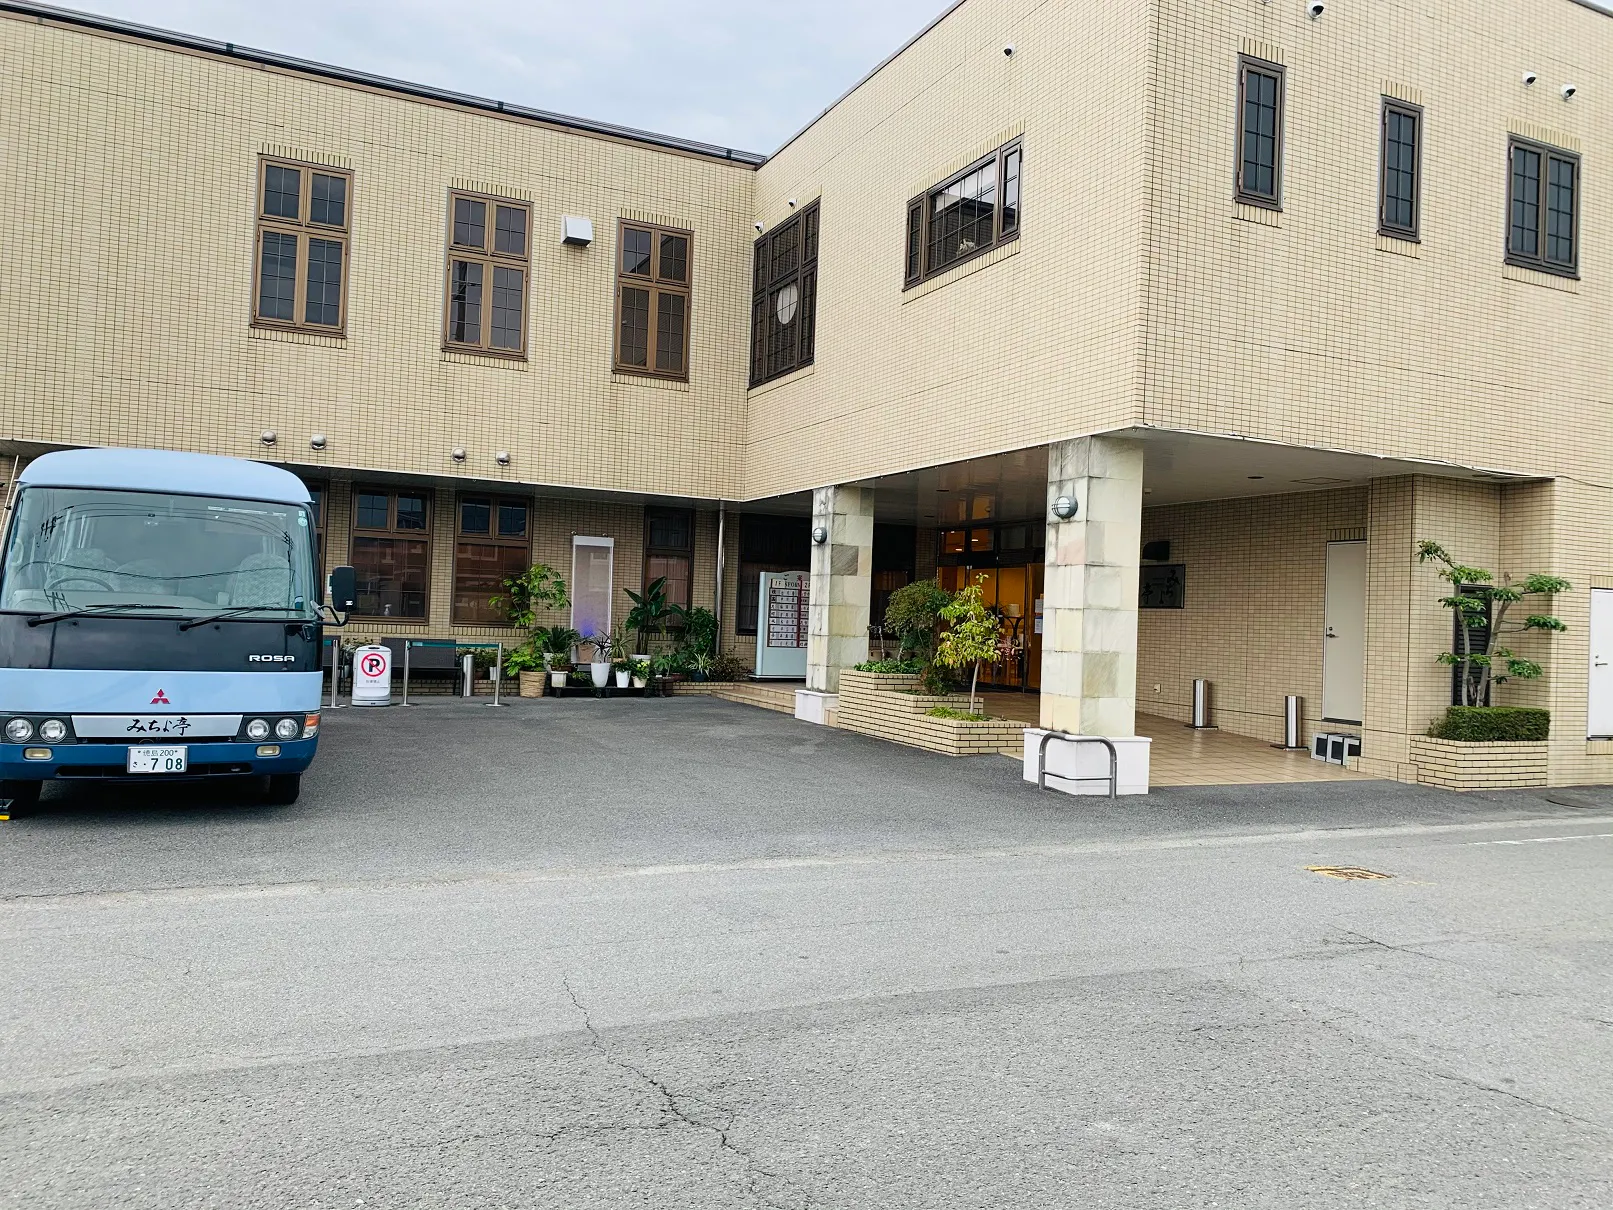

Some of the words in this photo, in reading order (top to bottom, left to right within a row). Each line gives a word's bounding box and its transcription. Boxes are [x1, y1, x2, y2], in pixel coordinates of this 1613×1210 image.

[249, 654, 295, 662] ROSA
[369, 659, 380, 672] P
[127, 717, 191, 736] みちよ亭
